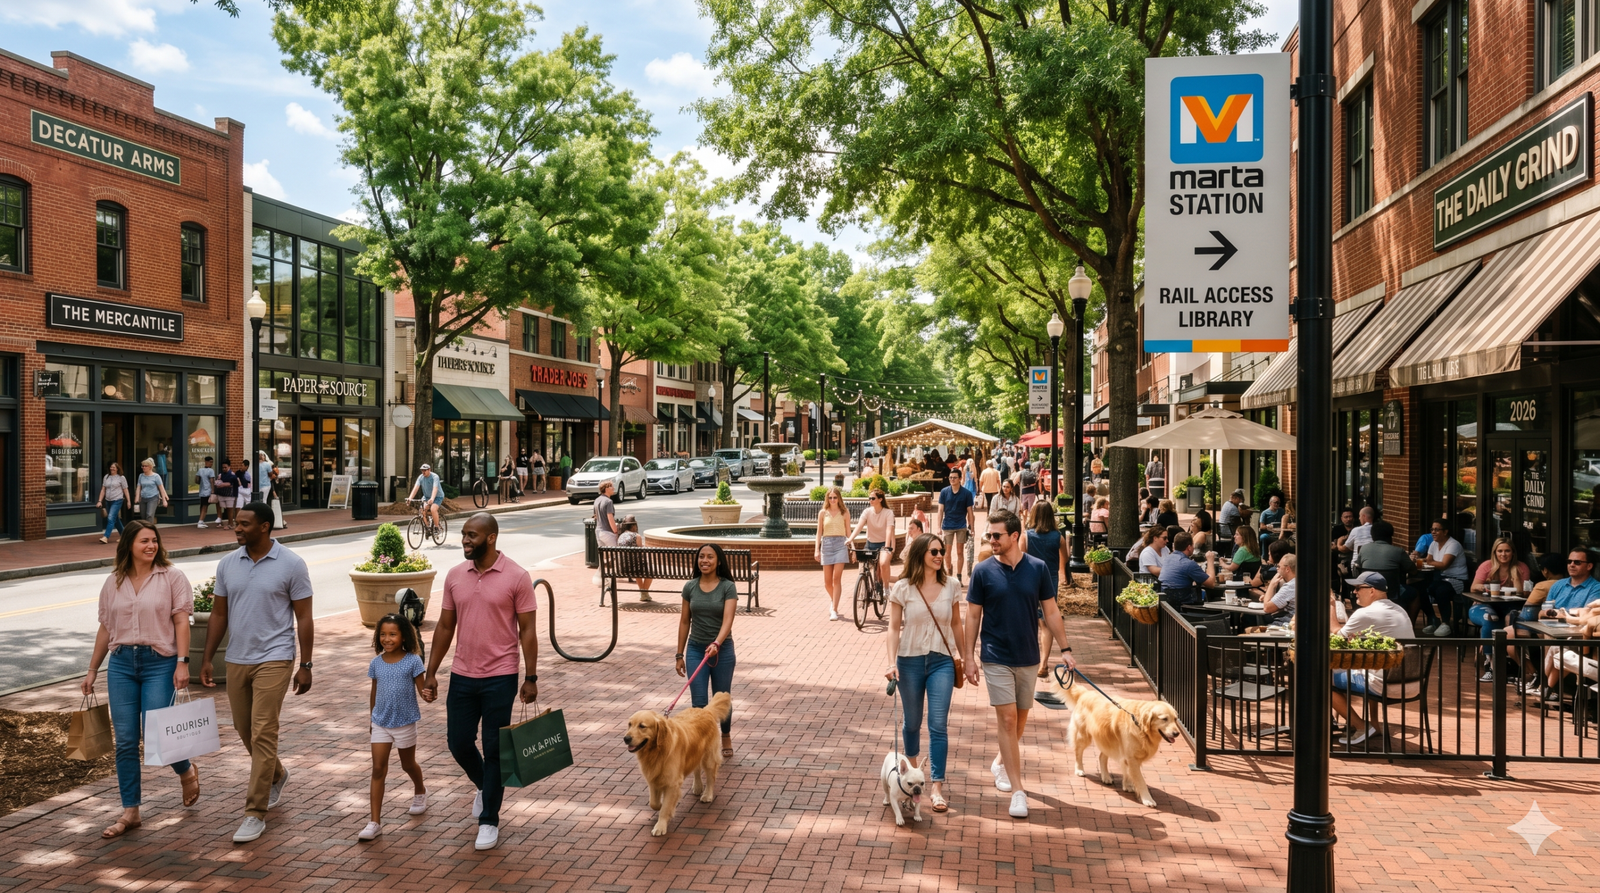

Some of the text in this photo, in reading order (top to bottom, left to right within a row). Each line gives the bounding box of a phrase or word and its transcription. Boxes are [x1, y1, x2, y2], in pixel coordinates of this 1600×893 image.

[39, 119, 175, 177] DECATUR ARMS
[1169, 166, 1264, 190] marta
[1436, 125, 1578, 232] THE DAILY GRIND
[1169, 192, 1264, 216] STATION
[1160, 286, 1274, 304] RAIL ACCESS
[62, 304, 175, 332] THE MERCANTILE
[1179, 310, 1254, 327] LIBRARY
[283, 377, 367, 397] PAPER SOURCE
[531, 364, 588, 389] TRADER JOE'S
[1510, 399, 1537, 422] 2026
[1524, 480, 1546, 494] DAILY
[1525, 494, 1545, 508] GRIND
[166, 717, 210, 736] FLOURISH
[522, 744, 538, 758] OAK
[537, 741, 545, 751] &
[543, 733, 562, 748] PINE
